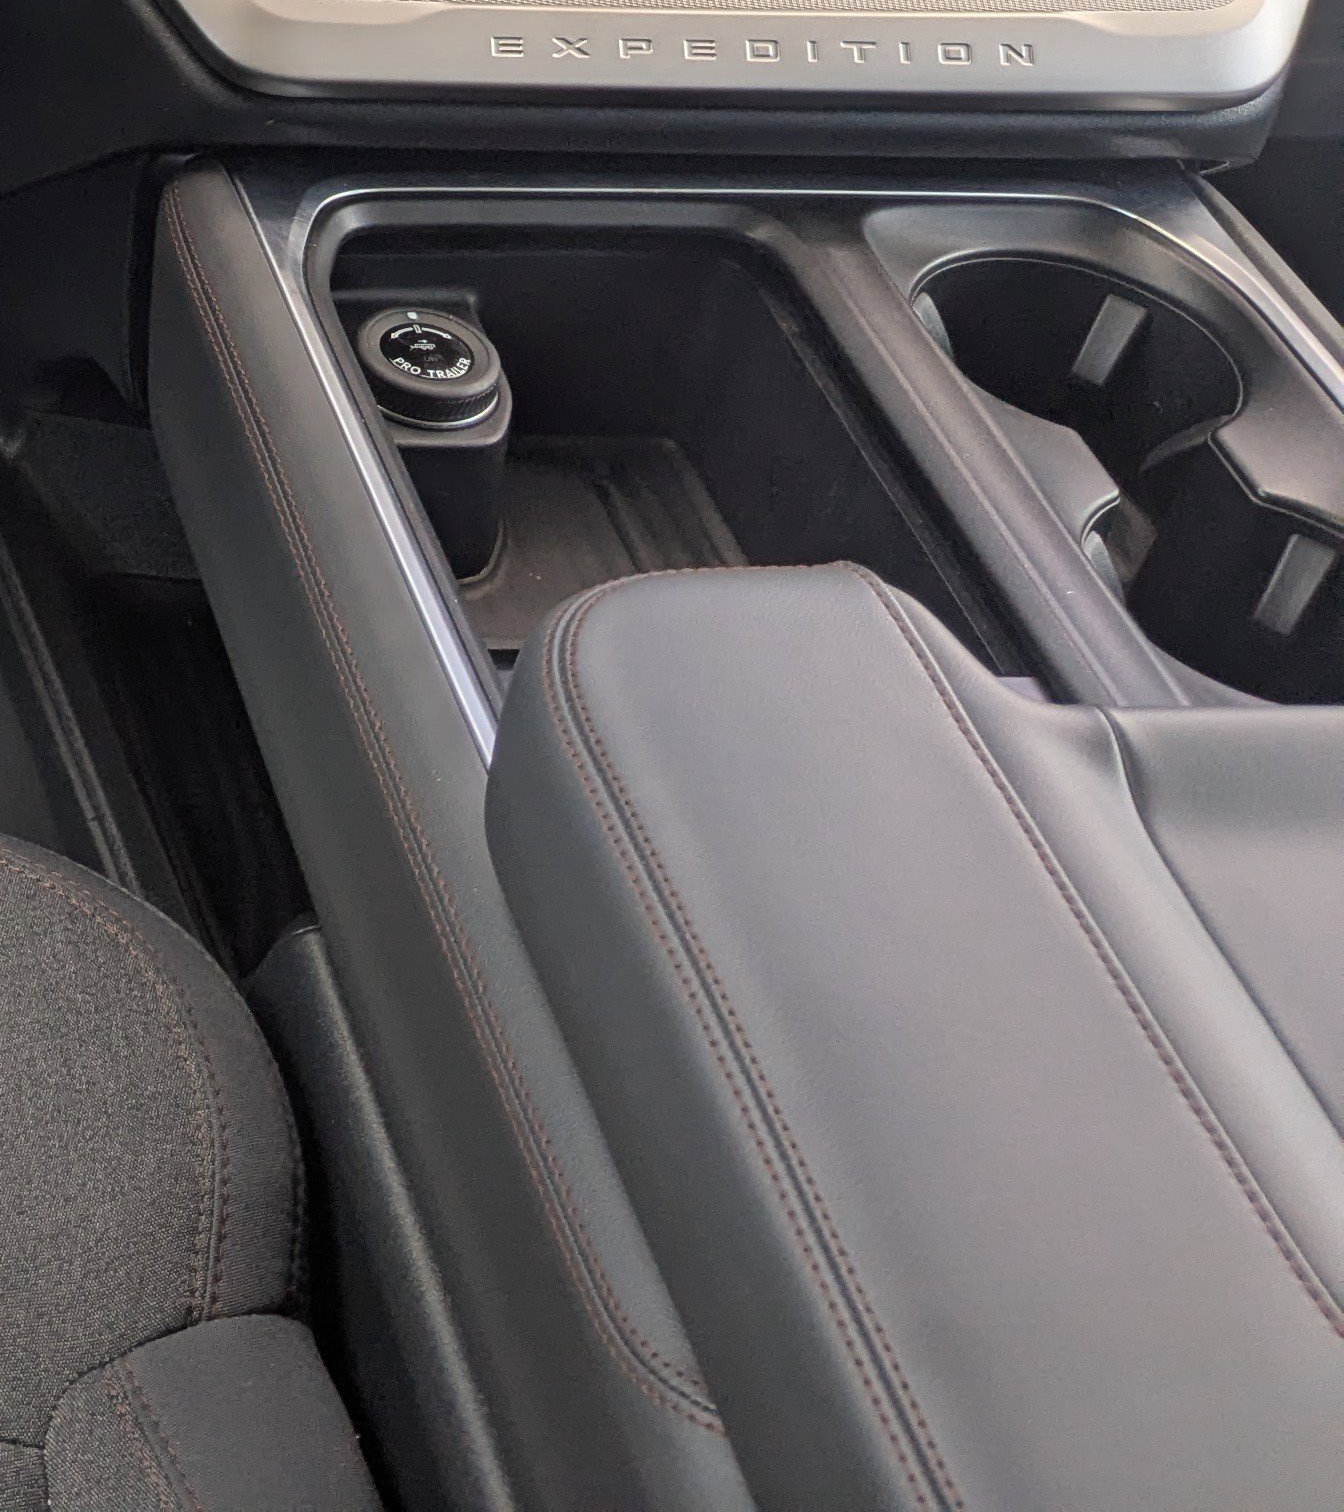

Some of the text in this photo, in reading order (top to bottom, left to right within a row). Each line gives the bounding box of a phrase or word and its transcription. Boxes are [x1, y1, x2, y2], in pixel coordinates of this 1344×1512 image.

[490, 36, 1035, 67] EXPEDITION
[393, 357, 421, 375] PRO
[427, 357, 472, 378] TRAILER
